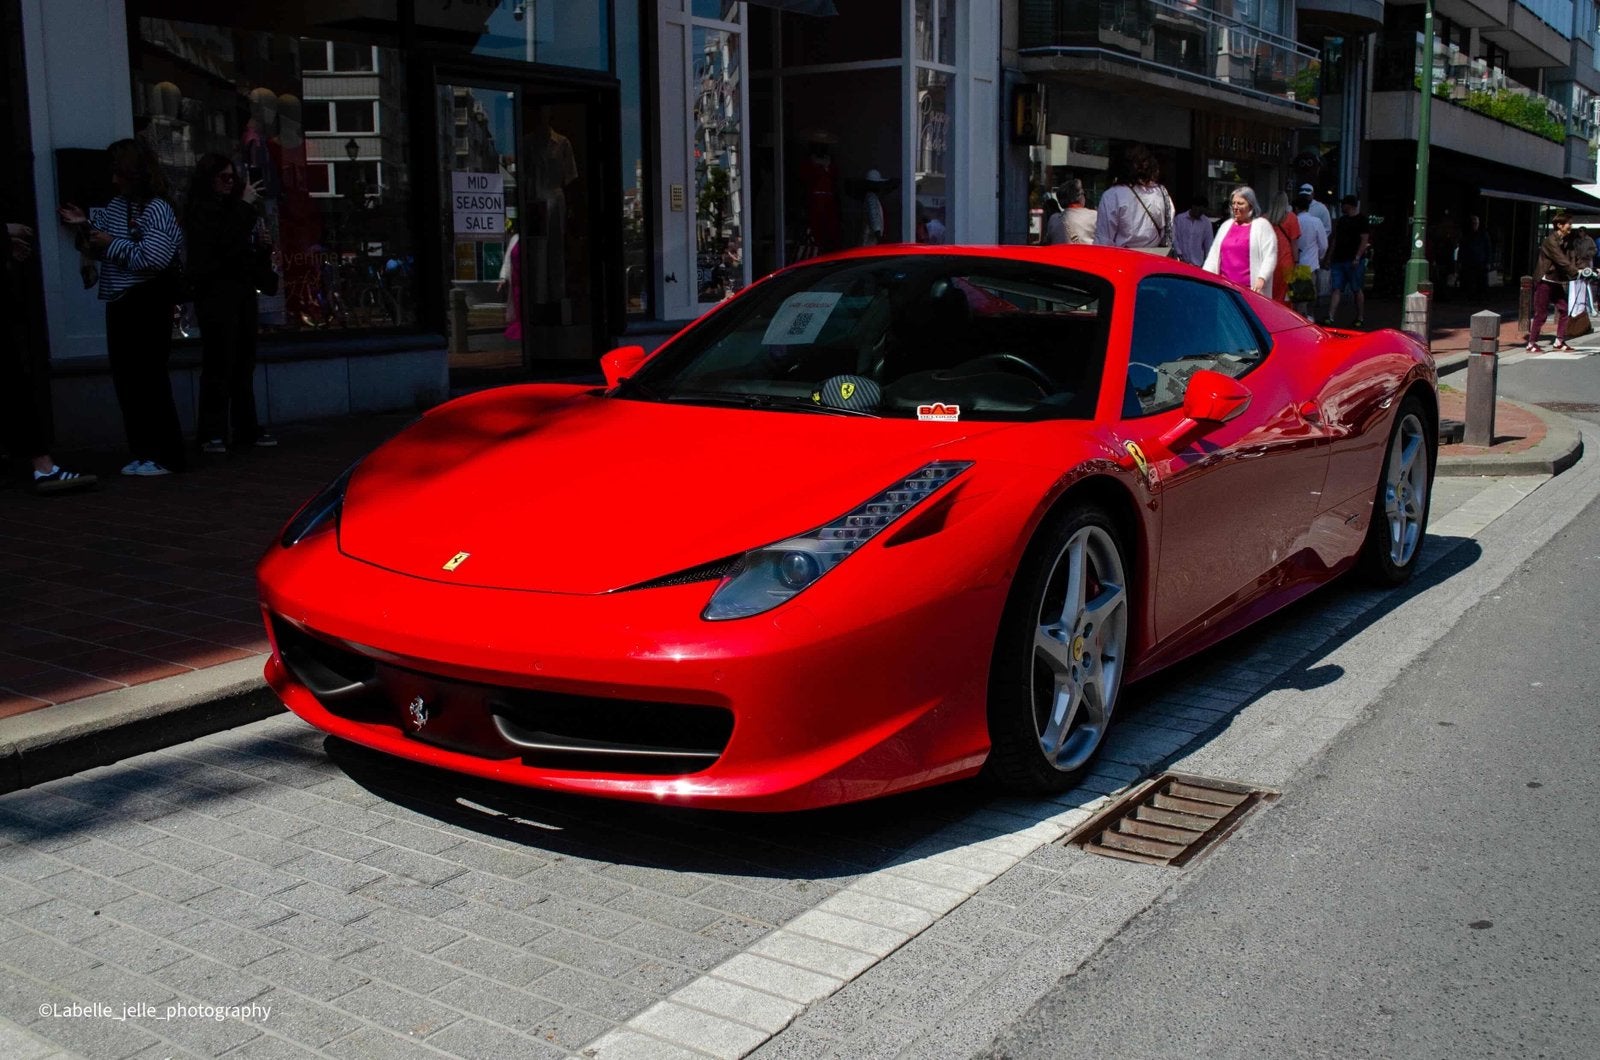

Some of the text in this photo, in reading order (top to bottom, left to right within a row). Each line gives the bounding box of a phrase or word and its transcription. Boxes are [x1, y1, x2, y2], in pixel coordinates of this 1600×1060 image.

[467, 176, 488, 190] MID
[456, 196, 502, 210] SEASON
[465, 217, 494, 230] SALE
[920, 404, 958, 415] BAS
